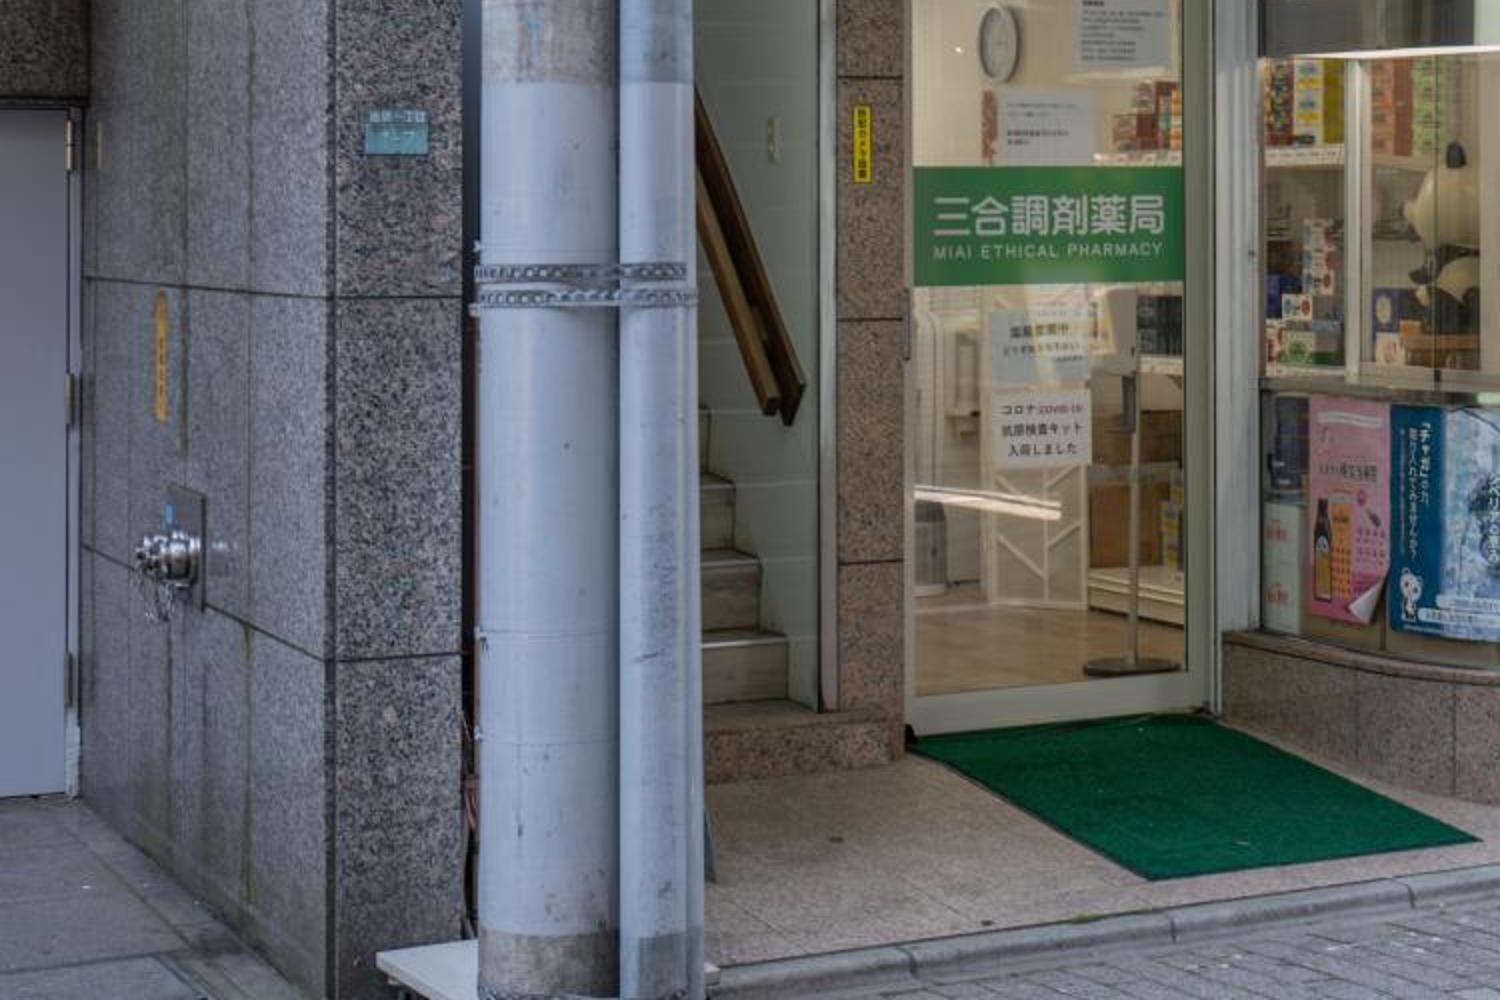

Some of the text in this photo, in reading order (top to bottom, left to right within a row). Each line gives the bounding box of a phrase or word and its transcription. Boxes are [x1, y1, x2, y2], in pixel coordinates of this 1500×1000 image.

[933, 195, 1165, 236] 三合調剤薬局
[933, 241, 1163, 260] MIAI ETHICAL PHARMACY
